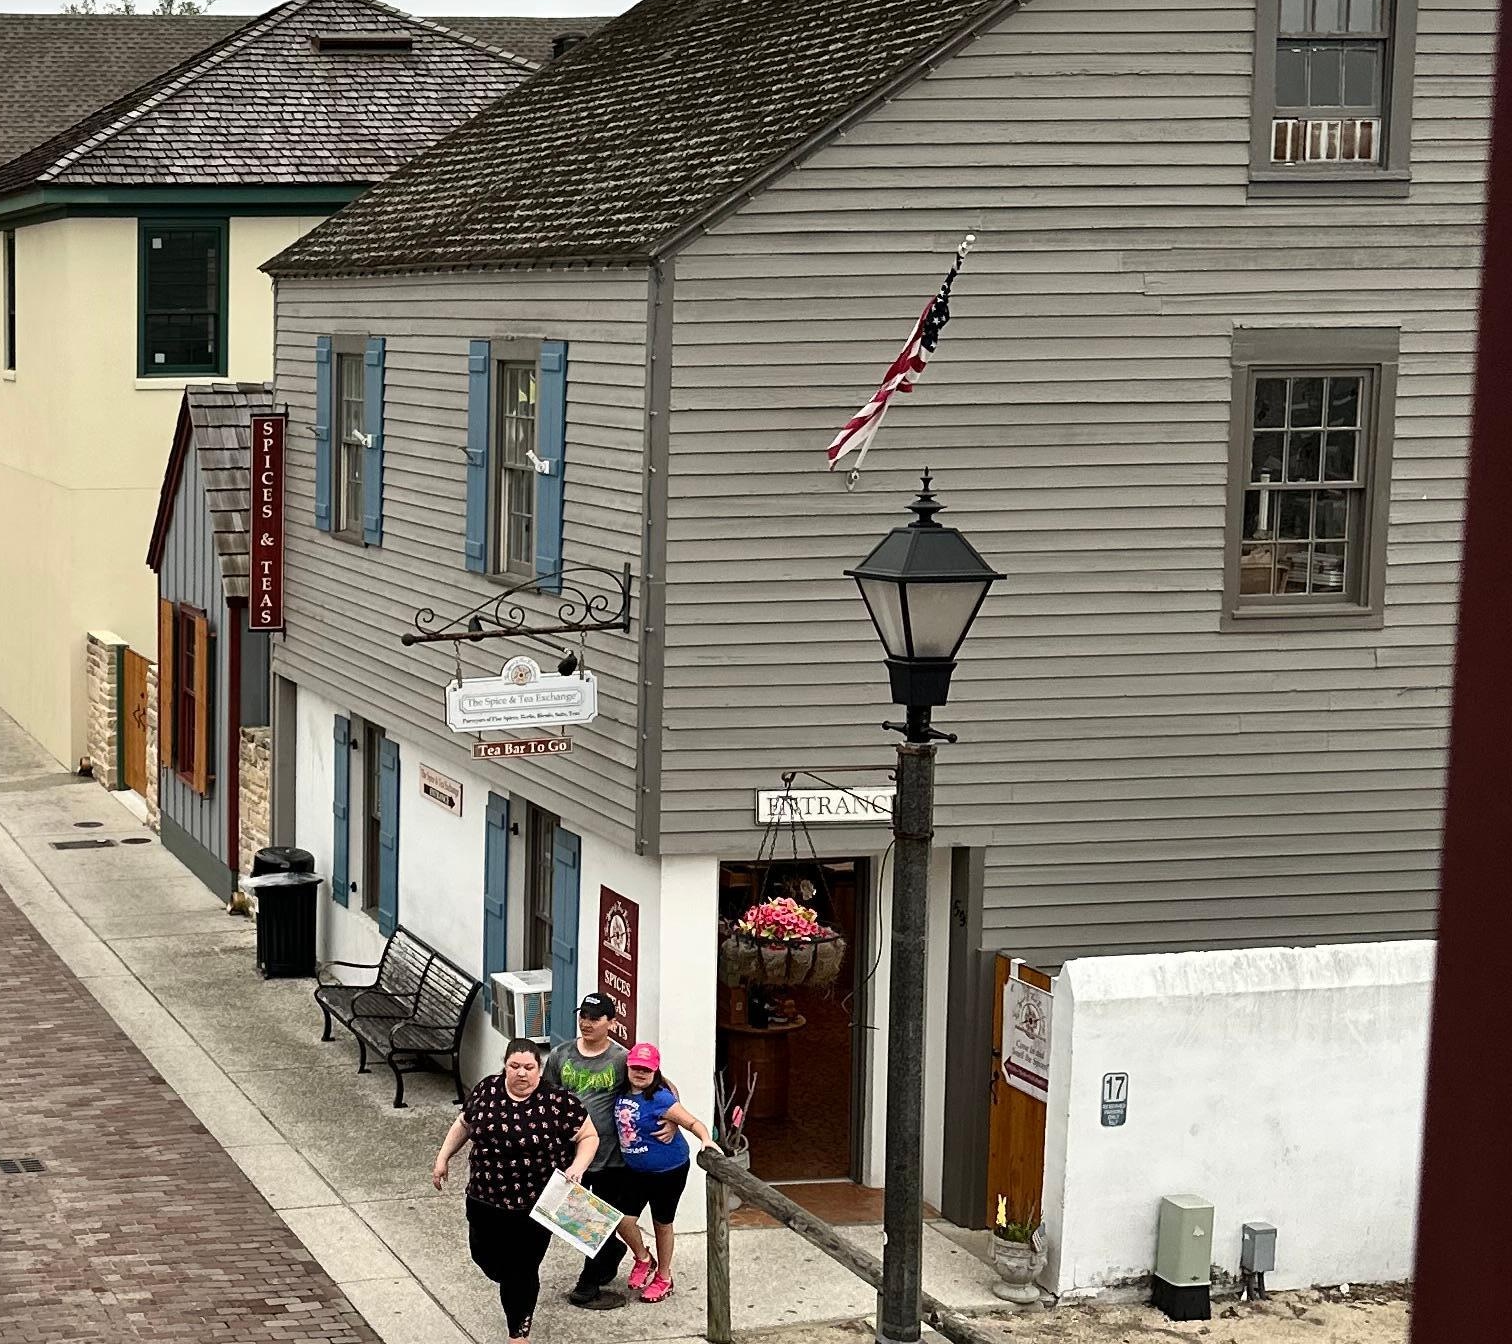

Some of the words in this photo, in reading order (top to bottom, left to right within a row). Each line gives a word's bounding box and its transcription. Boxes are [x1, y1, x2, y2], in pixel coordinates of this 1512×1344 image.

[261, 422, 274, 518] SPICES
[260, 533, 274, 546] &
[260, 561, 273, 624] TEAS
[484, 697, 507, 708] Spice
[519, 694, 534, 704] Tea
[478, 745, 501, 756] Tea
[504, 743, 526, 755] Bar
[528, 742, 545, 753] To
[548, 740, 567, 752] Go
[766, 794, 894, 816] ENTRANC
[604, 969, 631, 997] SPICES
[1106, 1076, 1125, 1100] 17
